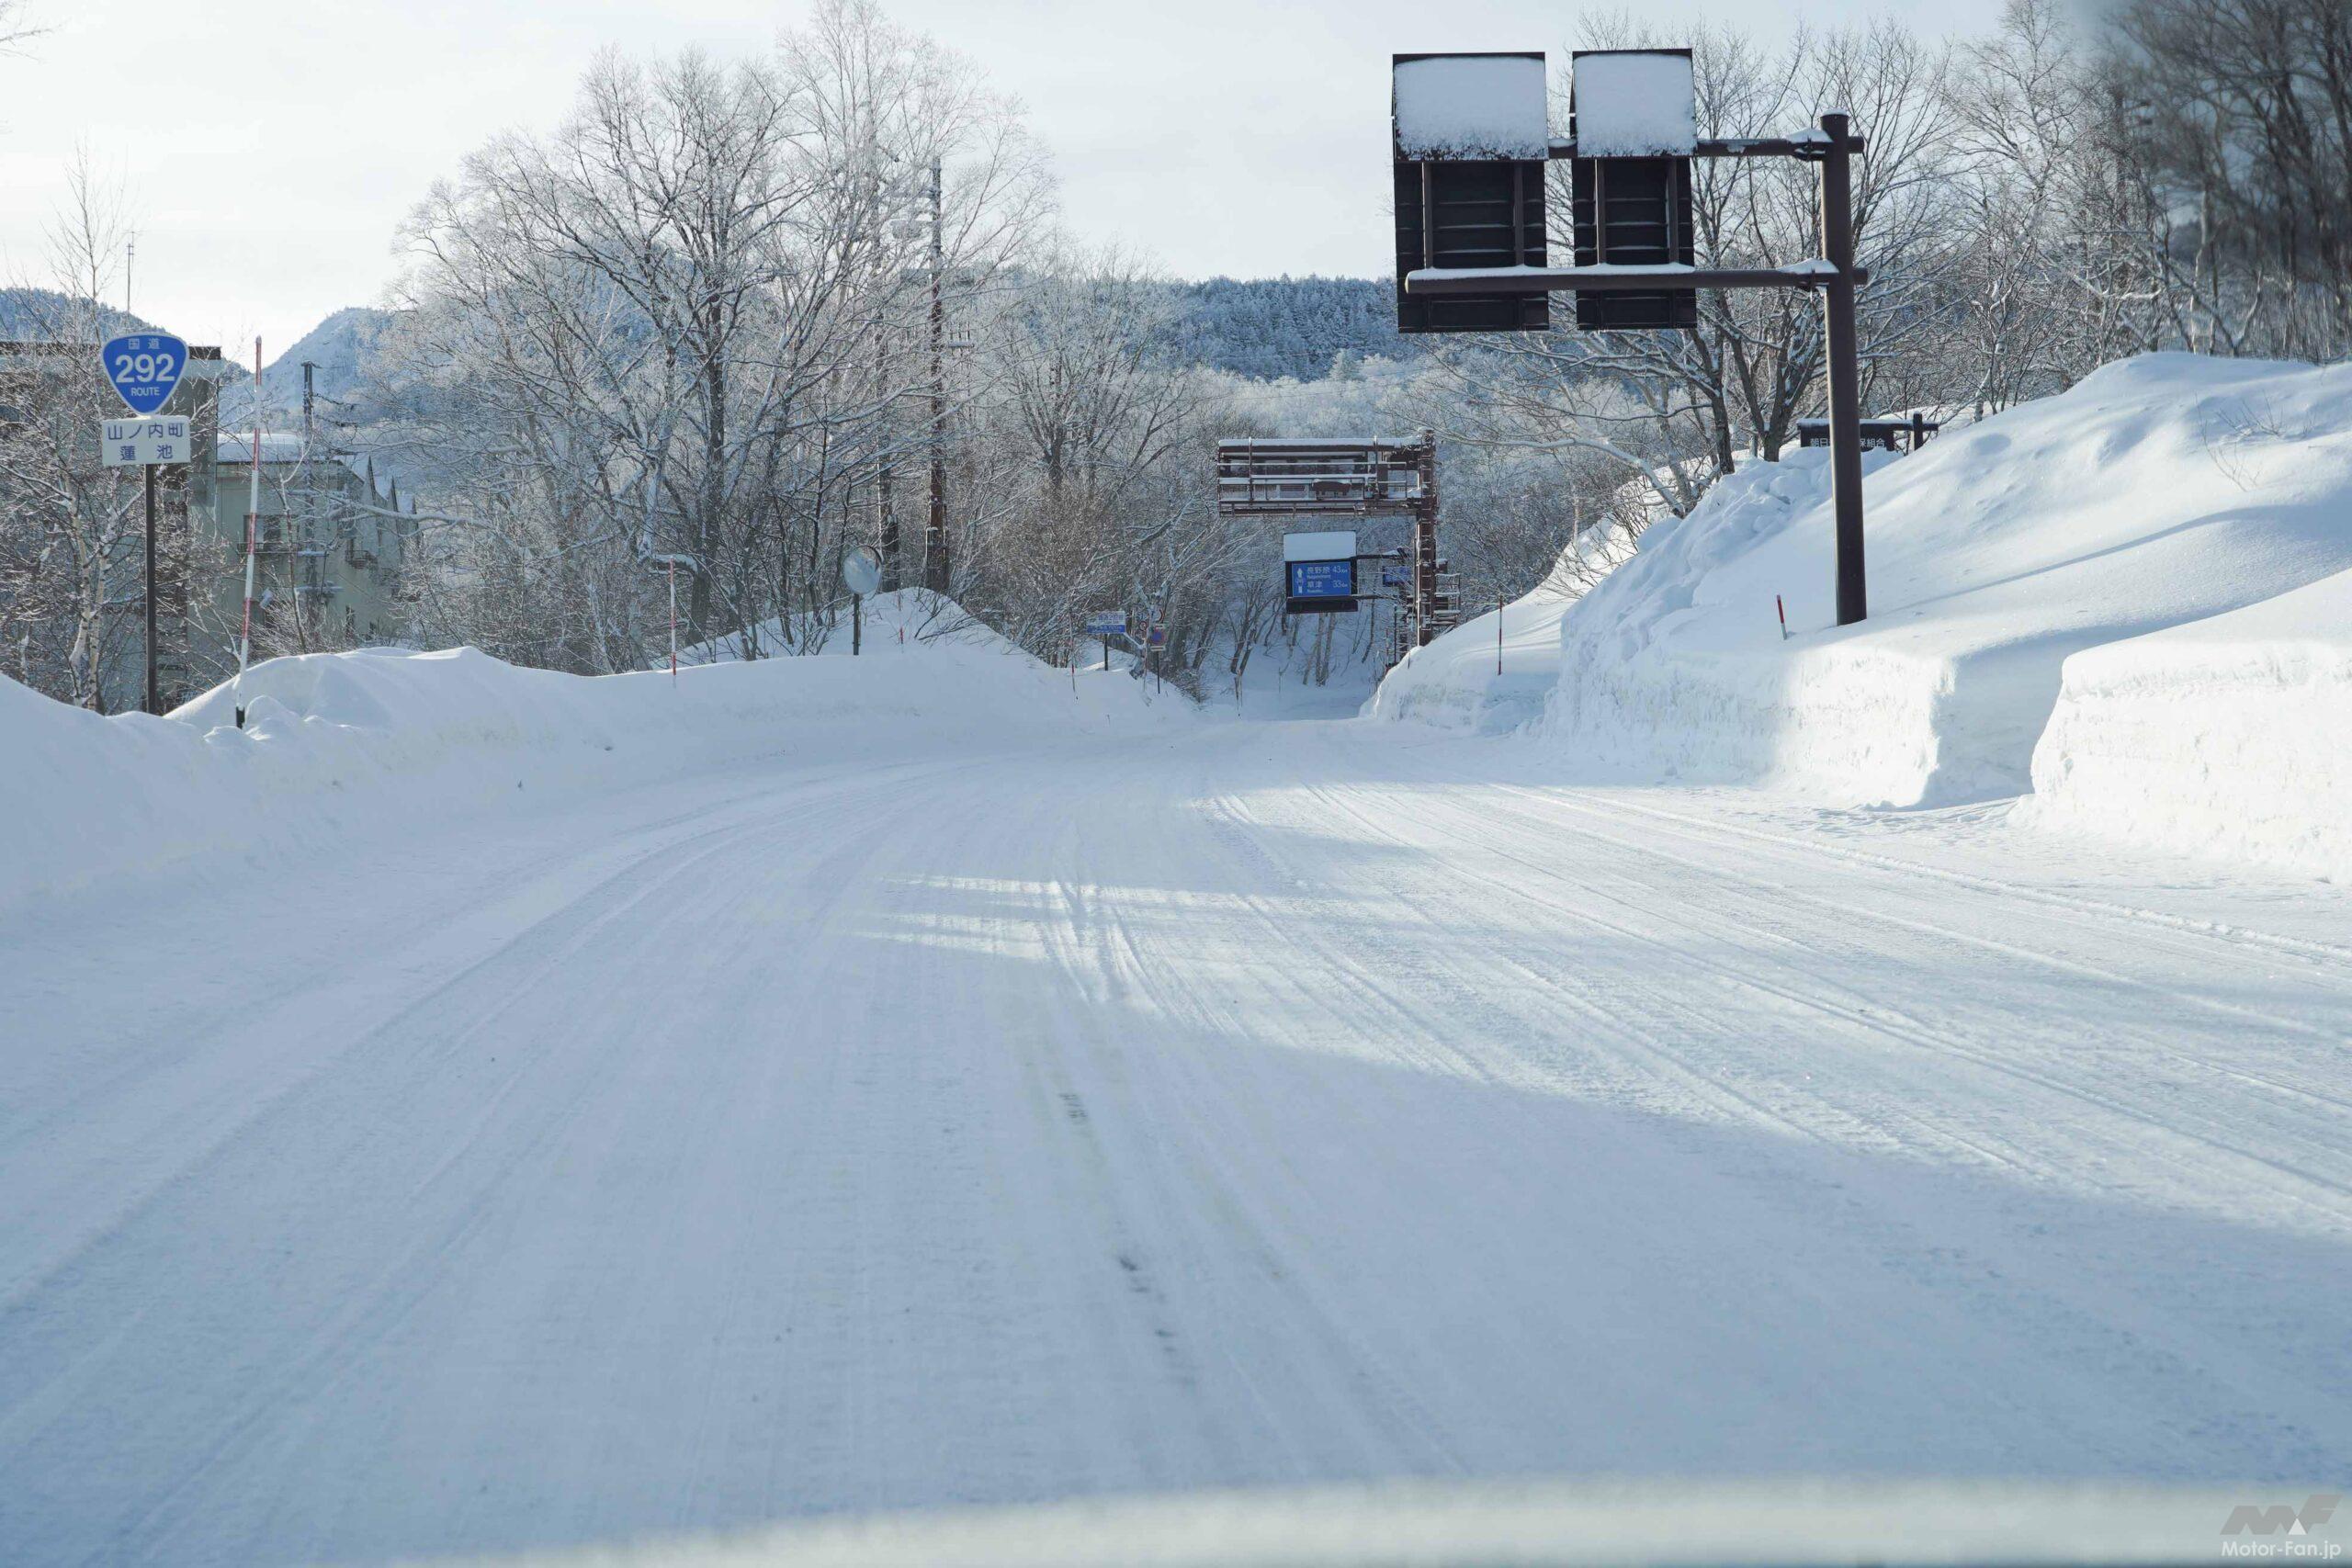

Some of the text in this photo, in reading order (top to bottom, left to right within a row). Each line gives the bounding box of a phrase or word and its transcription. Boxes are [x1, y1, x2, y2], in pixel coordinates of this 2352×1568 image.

[128, 338, 160, 350] 国道
[115, 353, 175, 383] 292
[130, 387, 160, 397] ROUTE
[107, 423, 183, 440] 山ノ内町
[120, 445, 173, 461] 蓮池
